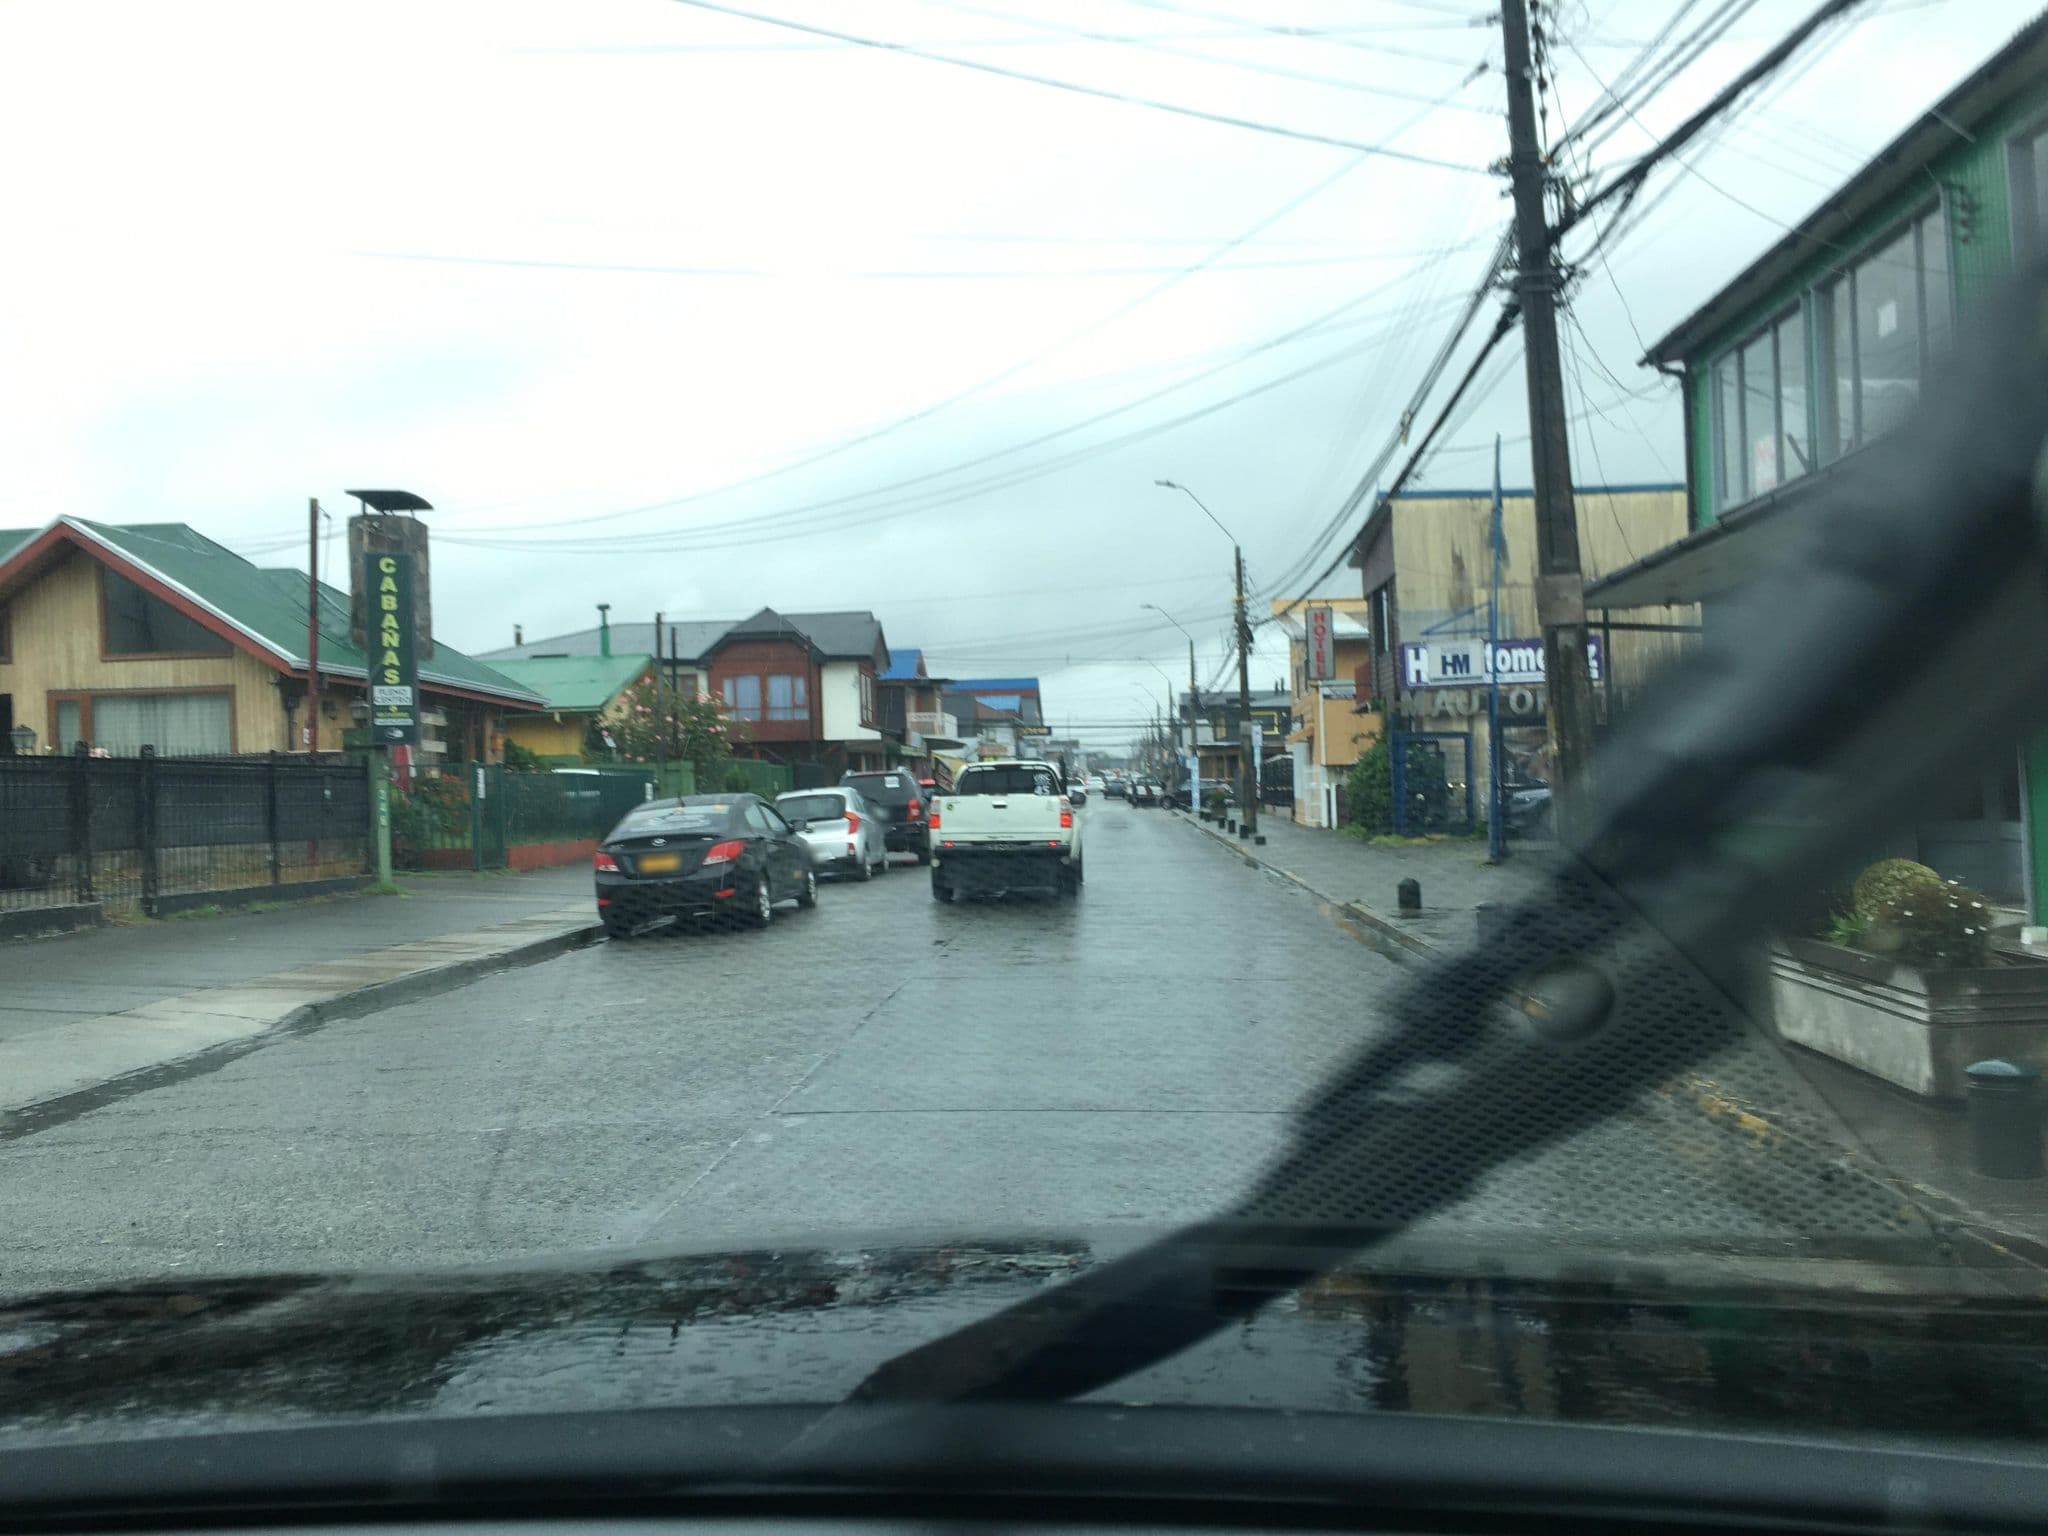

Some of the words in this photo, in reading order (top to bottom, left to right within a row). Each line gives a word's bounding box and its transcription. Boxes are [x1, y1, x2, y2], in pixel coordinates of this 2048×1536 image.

[379, 556, 400, 685] CABAÑAS
[1313, 611, 1327, 678] HOTEL
[1441, 654, 1471, 676] HM
